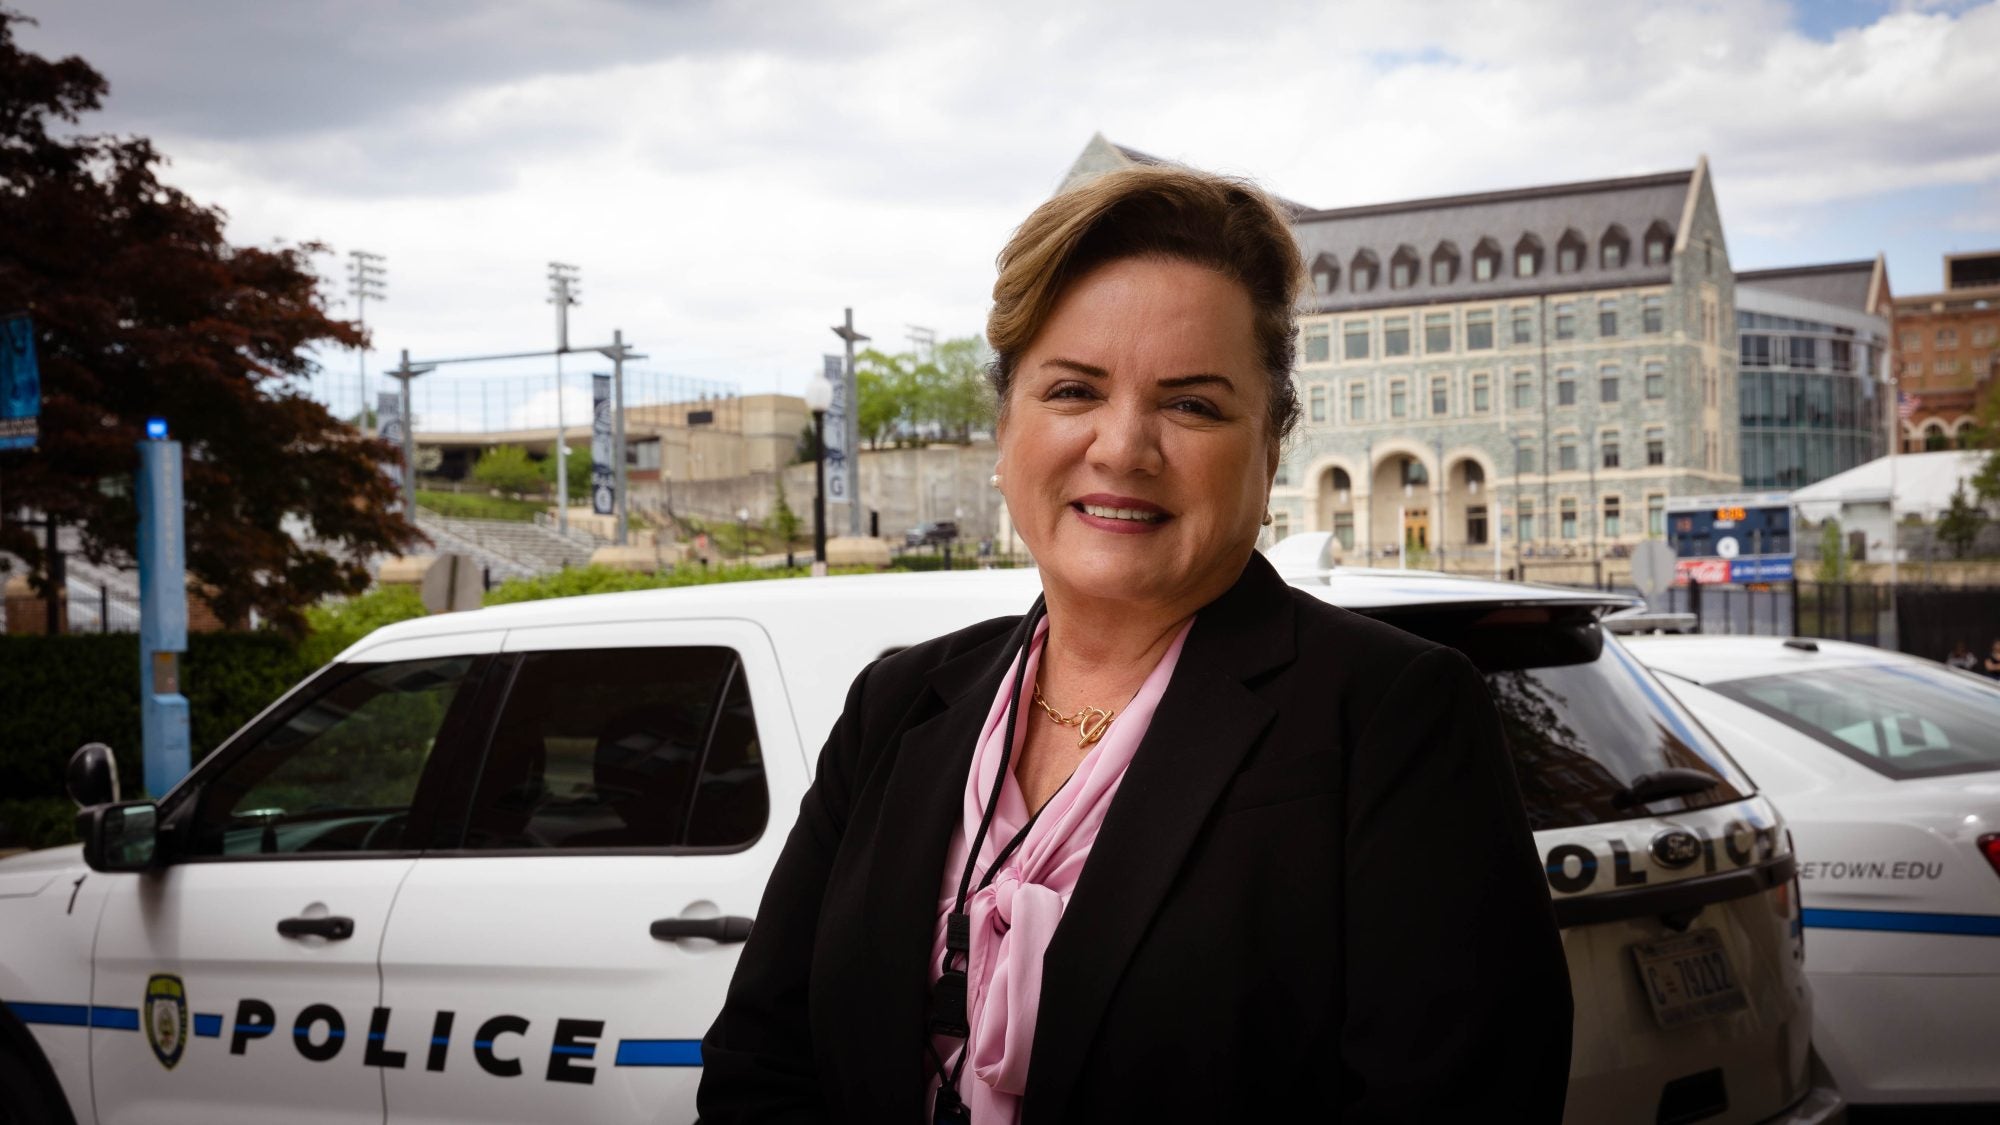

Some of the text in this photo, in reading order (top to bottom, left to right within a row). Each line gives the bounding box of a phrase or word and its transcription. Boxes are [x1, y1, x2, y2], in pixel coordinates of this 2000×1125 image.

[1546, 820, 1774, 893] OLIC
[1666, 834, 1695, 860] Ford
[230, 998, 605, 1086] POLICE
